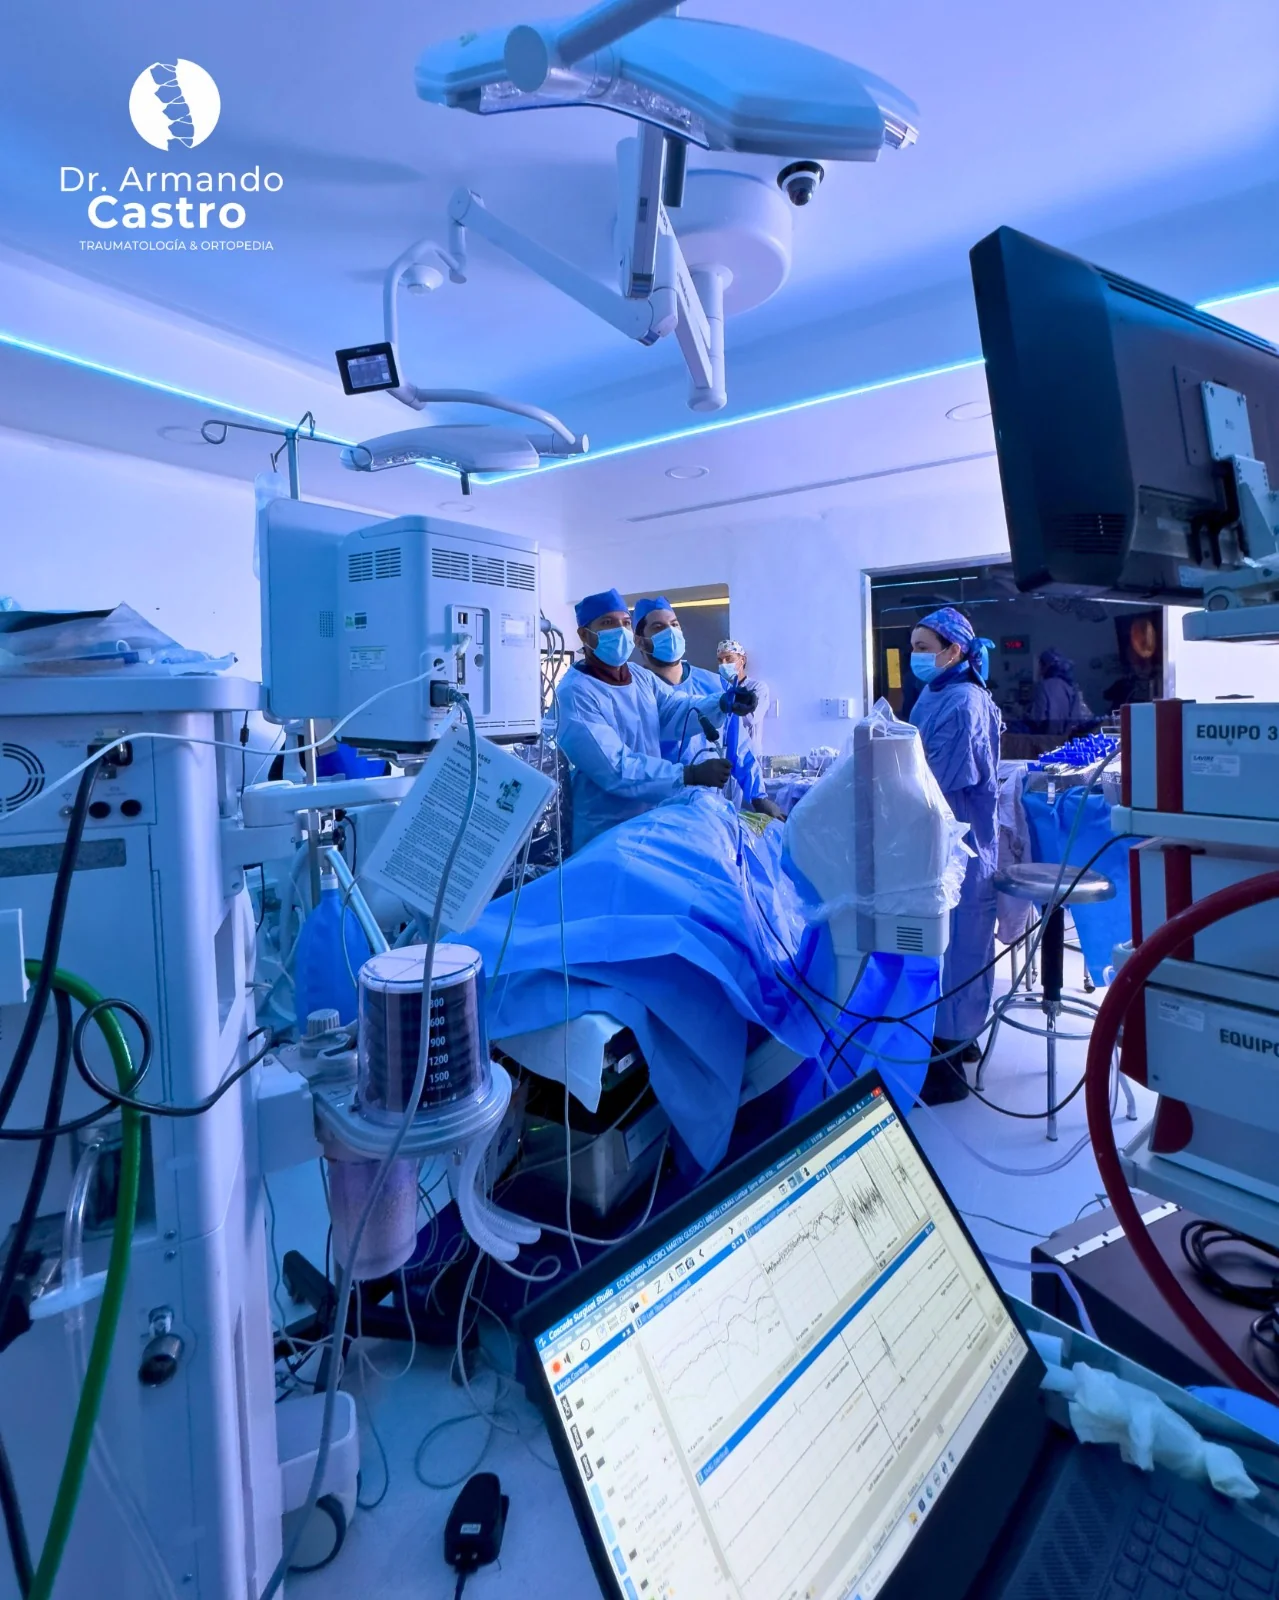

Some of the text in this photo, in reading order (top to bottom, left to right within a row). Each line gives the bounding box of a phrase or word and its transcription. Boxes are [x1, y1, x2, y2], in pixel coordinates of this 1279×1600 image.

[1195, 723, 1278, 741] EQUIPO 3
[429, 1016, 445, 1027] 600
[430, 1035, 446, 1047] 900
[428, 1053, 449, 1066] 1200
[429, 1070, 449, 1083] 1500
[546, 1316, 575, 1341] Cascade
[570, 1299, 598, 1324] Surgical
[593, 1286, 616, 1306] Studio
